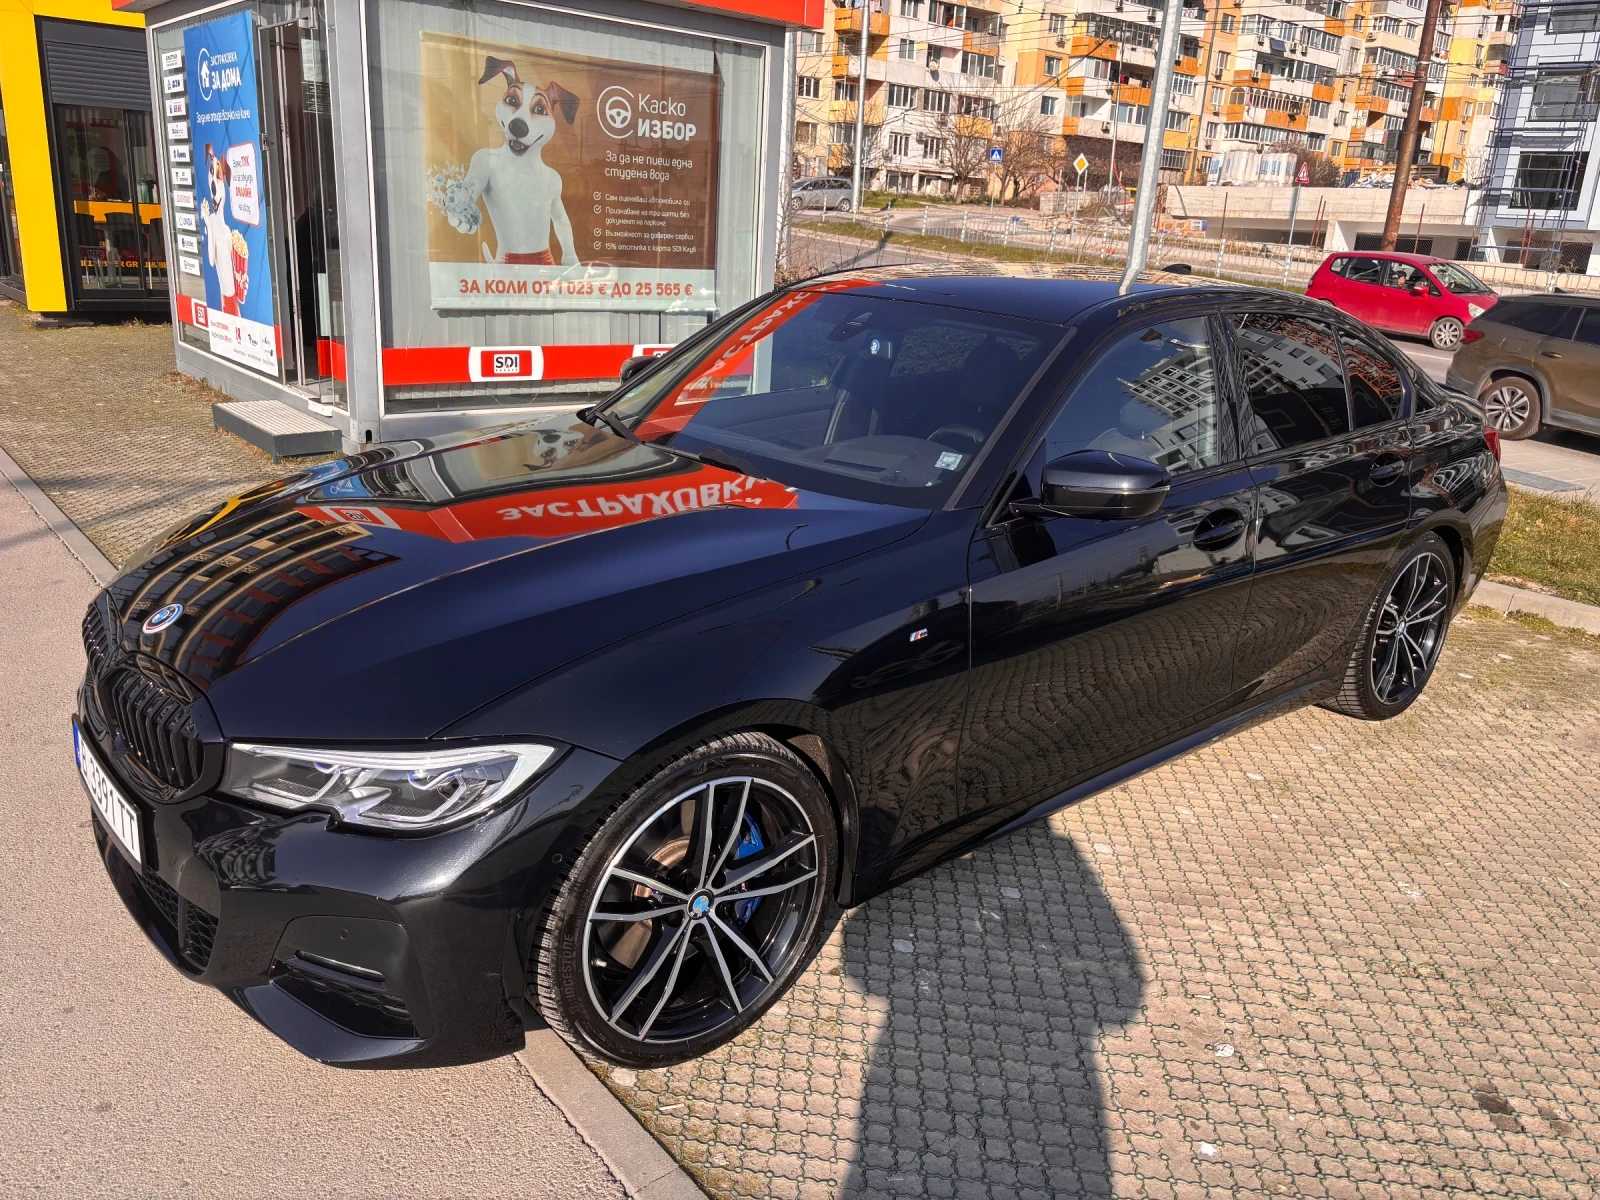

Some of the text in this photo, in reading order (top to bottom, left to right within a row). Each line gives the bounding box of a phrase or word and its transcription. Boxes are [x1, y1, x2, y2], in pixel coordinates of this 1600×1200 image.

[210, 51, 238, 66] ЗАСТРАХОВКА
[212, 66, 242, 92] ЗА ДОМА
[638, 94, 686, 116] Каско
[638, 118, 696, 141] ИЗБОР
[606, 150, 692, 169] За да не пиеш една
[605, 168, 669, 182] студена вода
[648, 197, 681, 205] автомобила
[606, 206, 640, 216] Признаване
[460, 279, 693, 298] ЗА КОЛИ ОТ 1 023 € ДО 25 565 €
[496, 356, 518, 368] SDI
[118, 799, 135, 851] TT
[562, 933, 579, 1016] BRIDGESTONE
